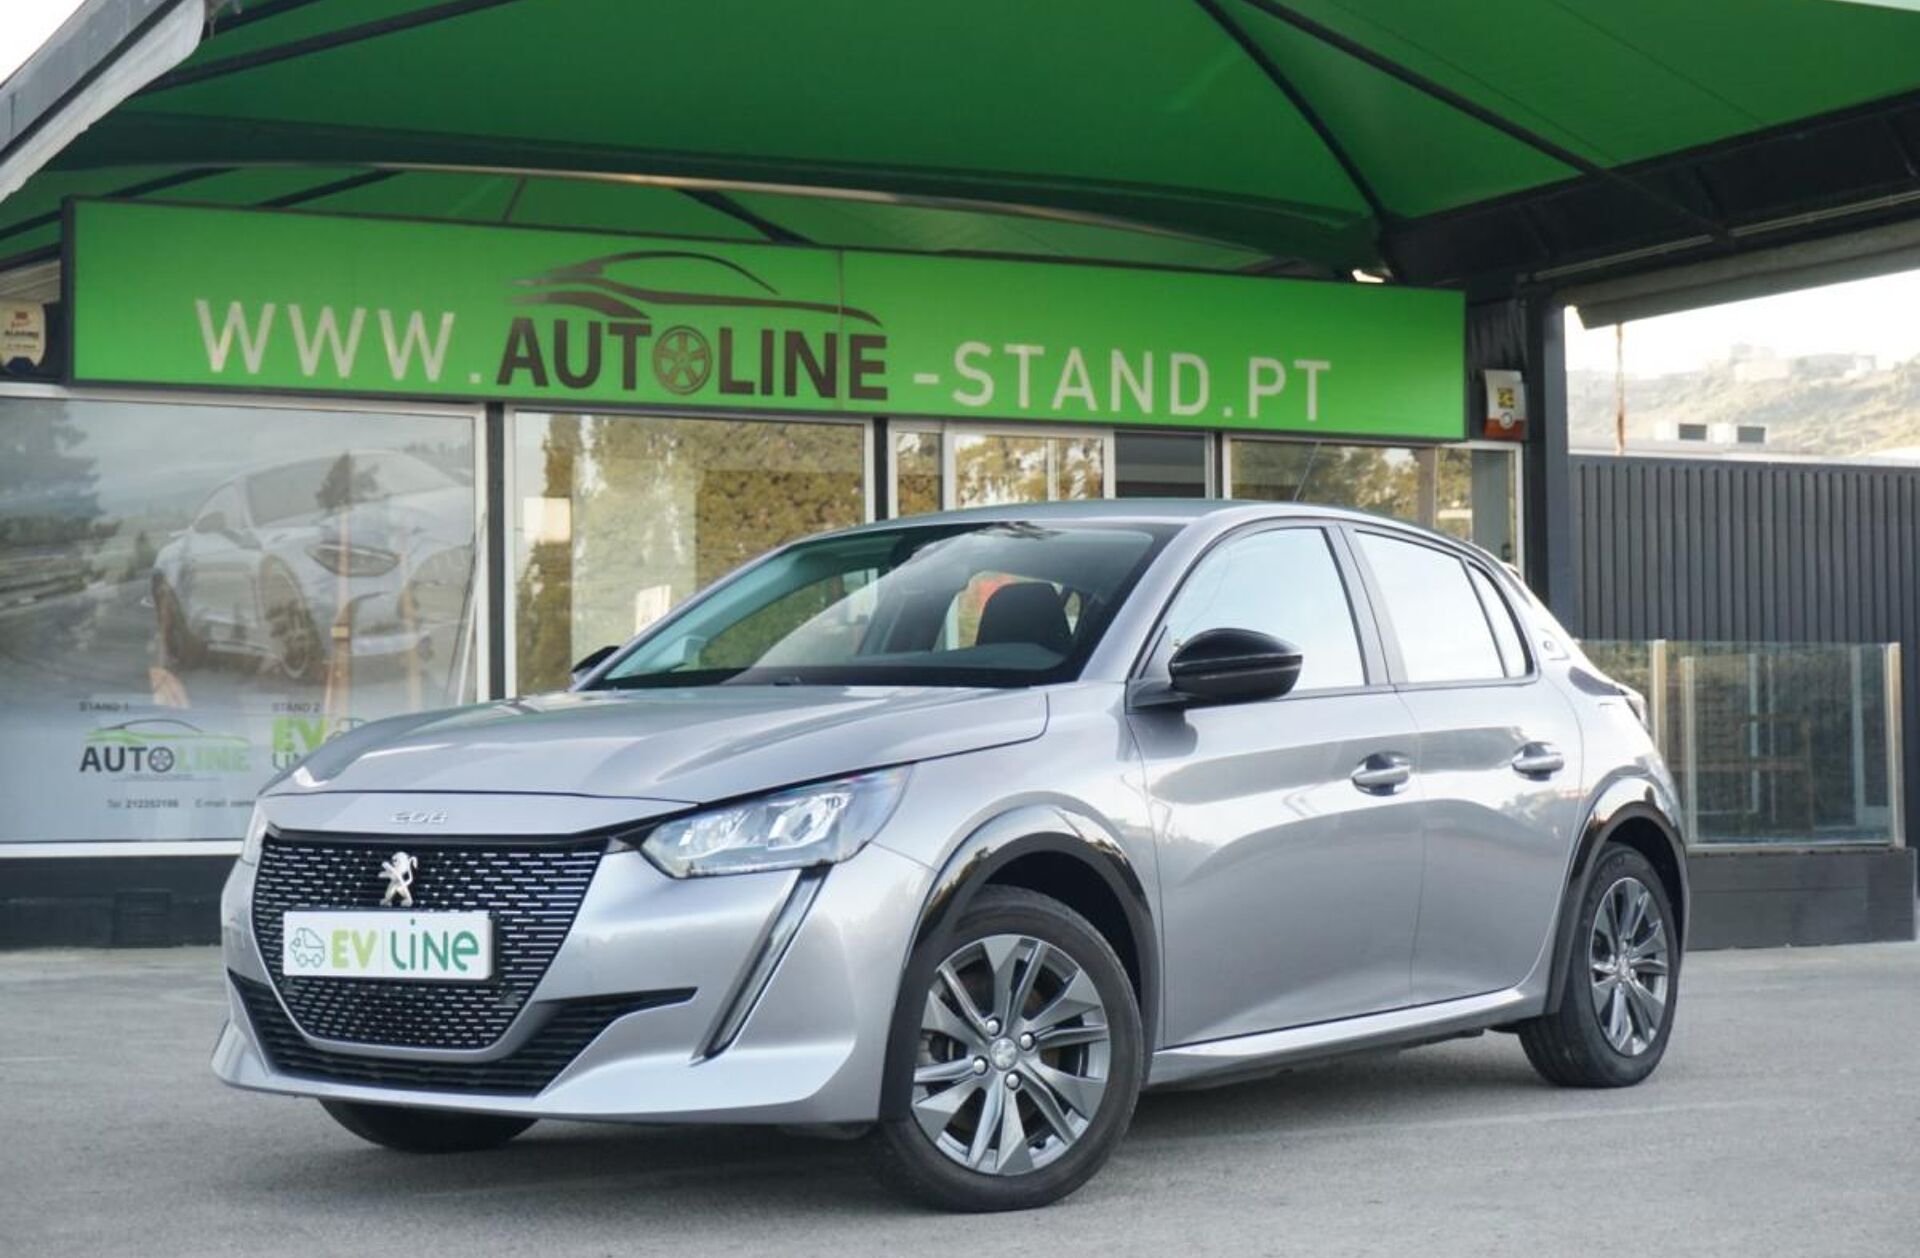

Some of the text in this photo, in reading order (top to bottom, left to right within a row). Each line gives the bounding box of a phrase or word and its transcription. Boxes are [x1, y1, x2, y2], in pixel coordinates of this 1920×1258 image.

[271, 702, 310, 713] STAND
[272, 717, 328, 752] EV
[79, 745, 252, 773] AUTOLINE
[332, 929, 376, 969] EV
